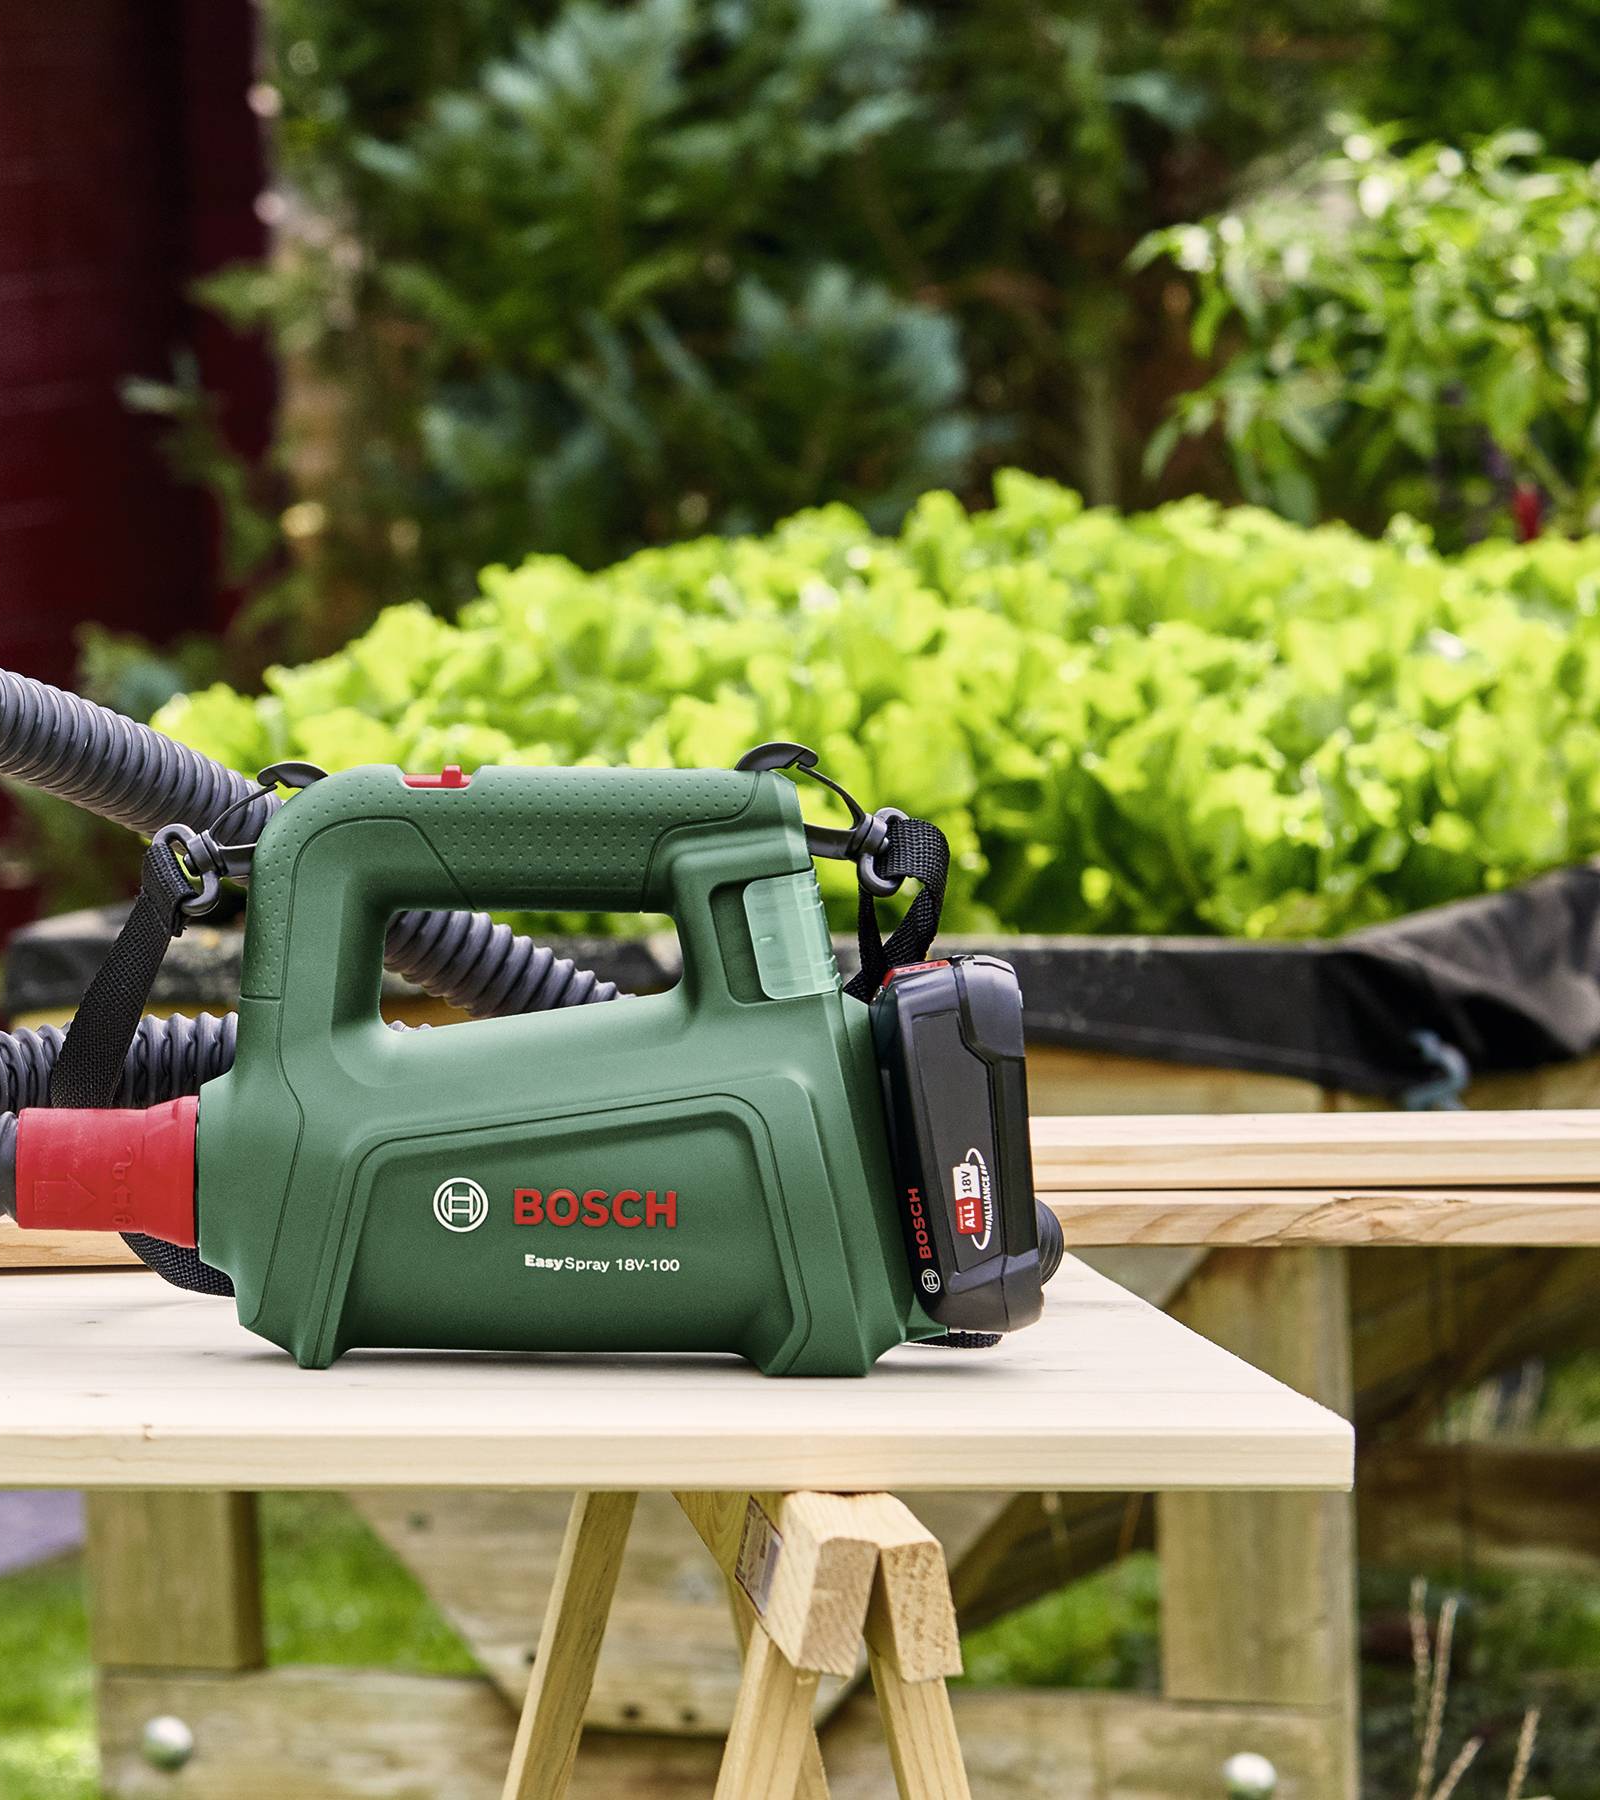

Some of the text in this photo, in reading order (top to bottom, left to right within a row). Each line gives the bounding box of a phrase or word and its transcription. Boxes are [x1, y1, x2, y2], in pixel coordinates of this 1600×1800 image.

[960, 1170, 973, 1193] 18V
[513, 1188, 678, 1228] BOSCH
[963, 1201, 976, 1228] ALL
[907, 1188, 933, 1260] BOSCH
[524, 1253, 681, 1273] EasySpray 18V-100
